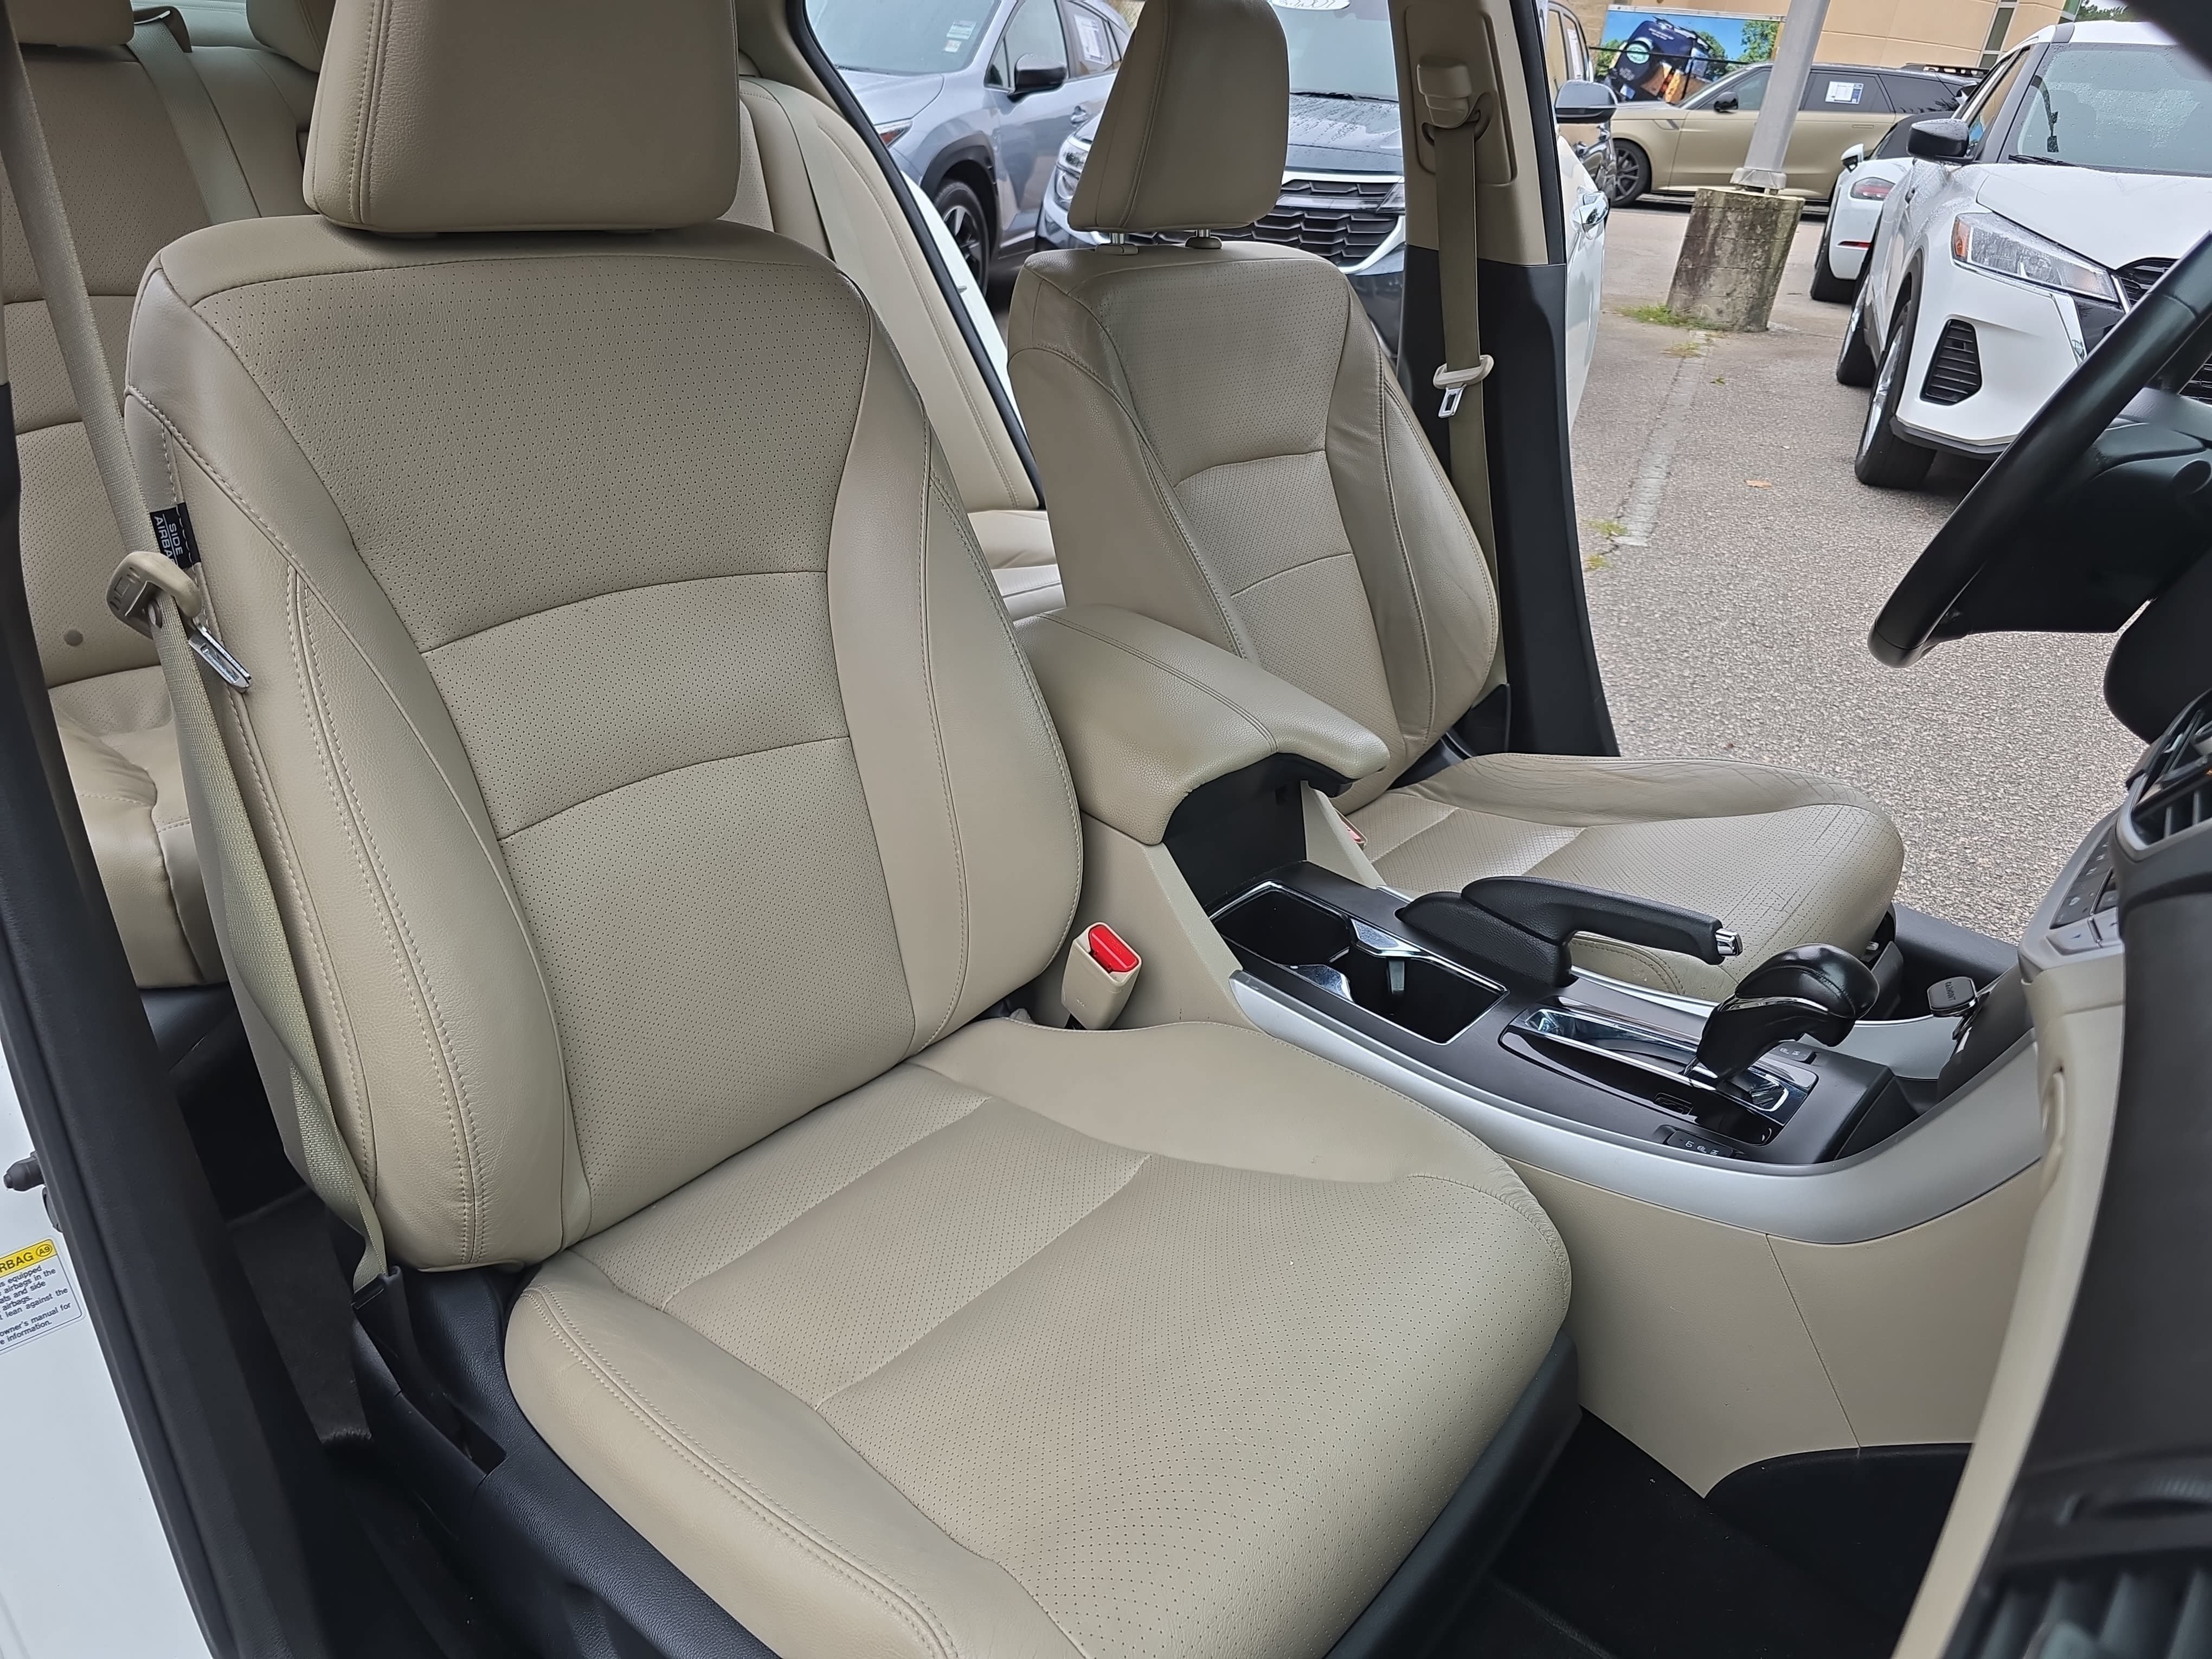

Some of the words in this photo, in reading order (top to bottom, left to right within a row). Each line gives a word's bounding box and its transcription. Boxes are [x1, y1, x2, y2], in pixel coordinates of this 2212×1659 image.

[169, 523, 183, 556] SIDE
[39, 1246, 50, 1255] A9
[4, 1278, 32, 1294] airbags
[43, 1269, 56, 1277] the
[8, 1264, 42, 1283] equipped
[13, 1287, 28, 1298] and
[30, 1281, 46, 1291] side
[2, 1296, 33, 1311] airbags.
[5, 1307, 23, 1317] lean
[25, 1293, 53, 1309] against
[55, 1288, 68, 1296] the
[0, 1321, 29, 1336] owner's
[31, 1307, 59, 1323] manual
[60, 1303, 71, 1311] for
[7, 1320, 52, 1341] information.
